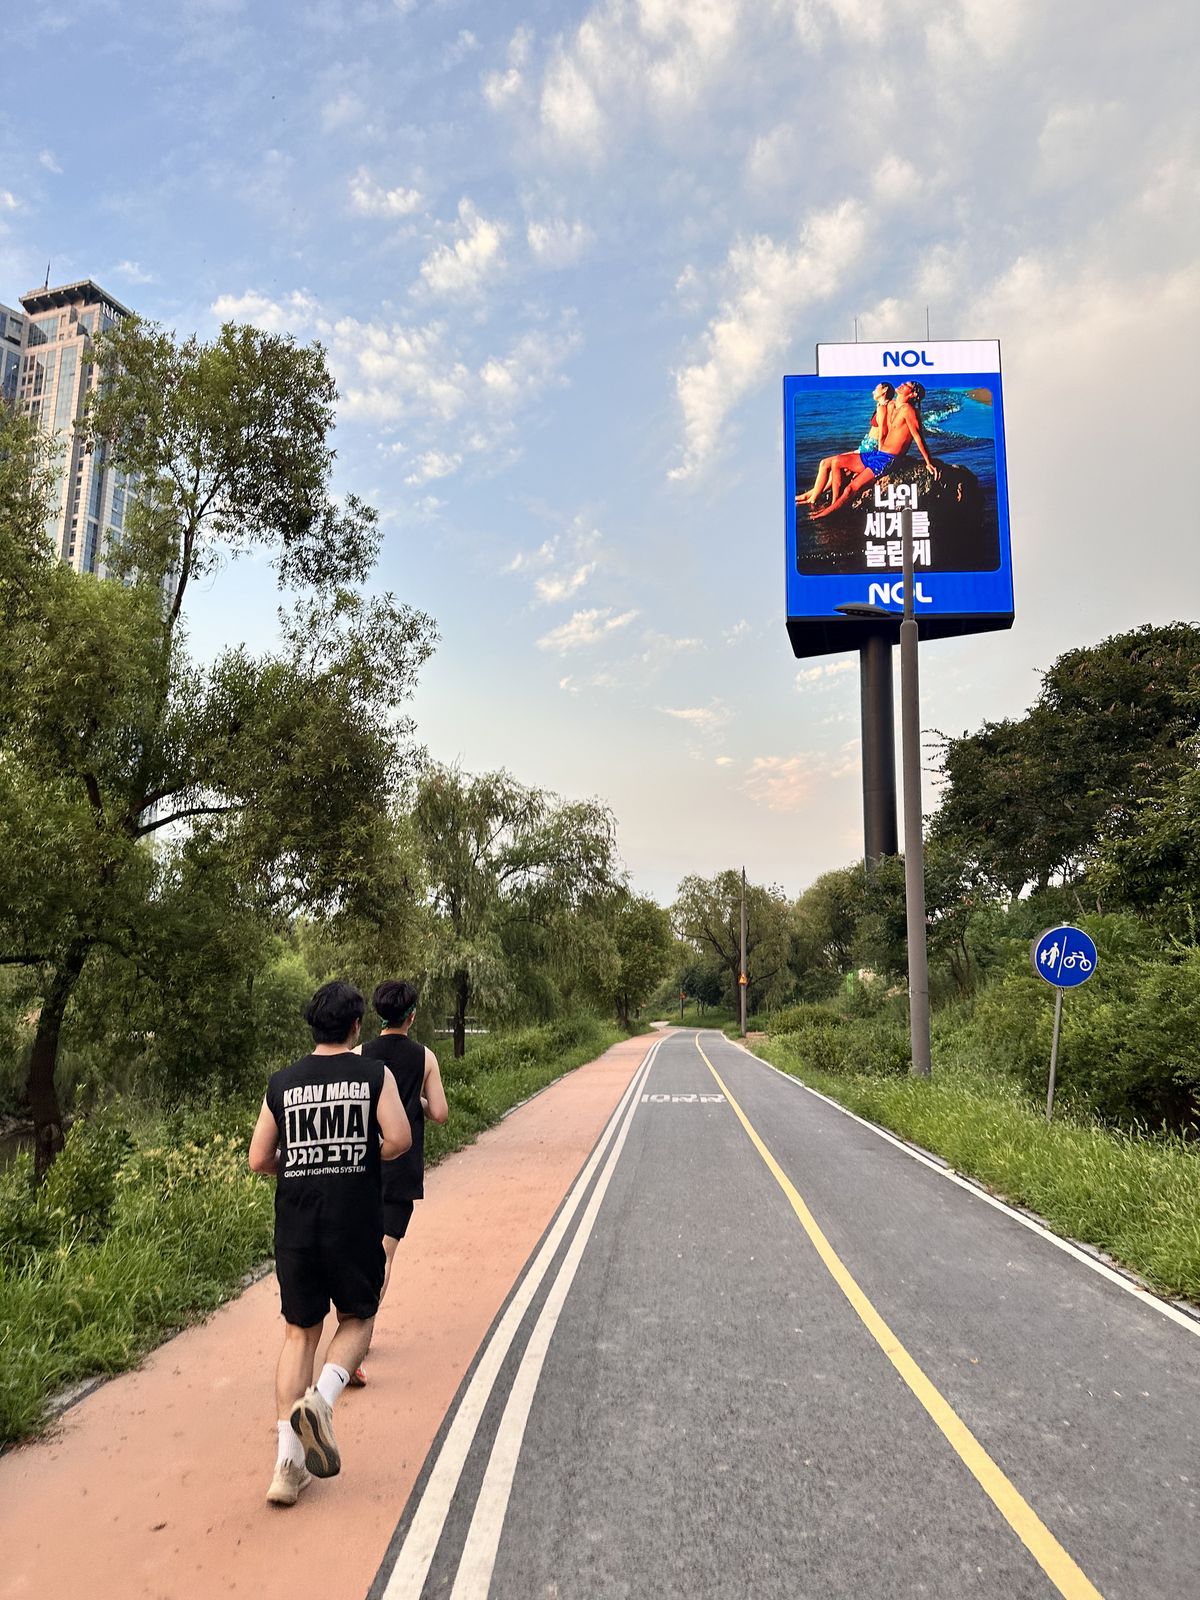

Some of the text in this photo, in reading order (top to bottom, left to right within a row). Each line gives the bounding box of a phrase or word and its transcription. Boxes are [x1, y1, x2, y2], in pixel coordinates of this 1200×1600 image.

[883, 349, 934, 368] NOL
[874, 483, 918, 510] 나의
[283, 1081, 370, 1108] KRAV MAGA
[288, 1104, 366, 1144] IKMA
[285, 1143, 368, 1168] קרב מגע
[283, 1165, 366, 1178] GIDON FIGHTING SYSTEM
